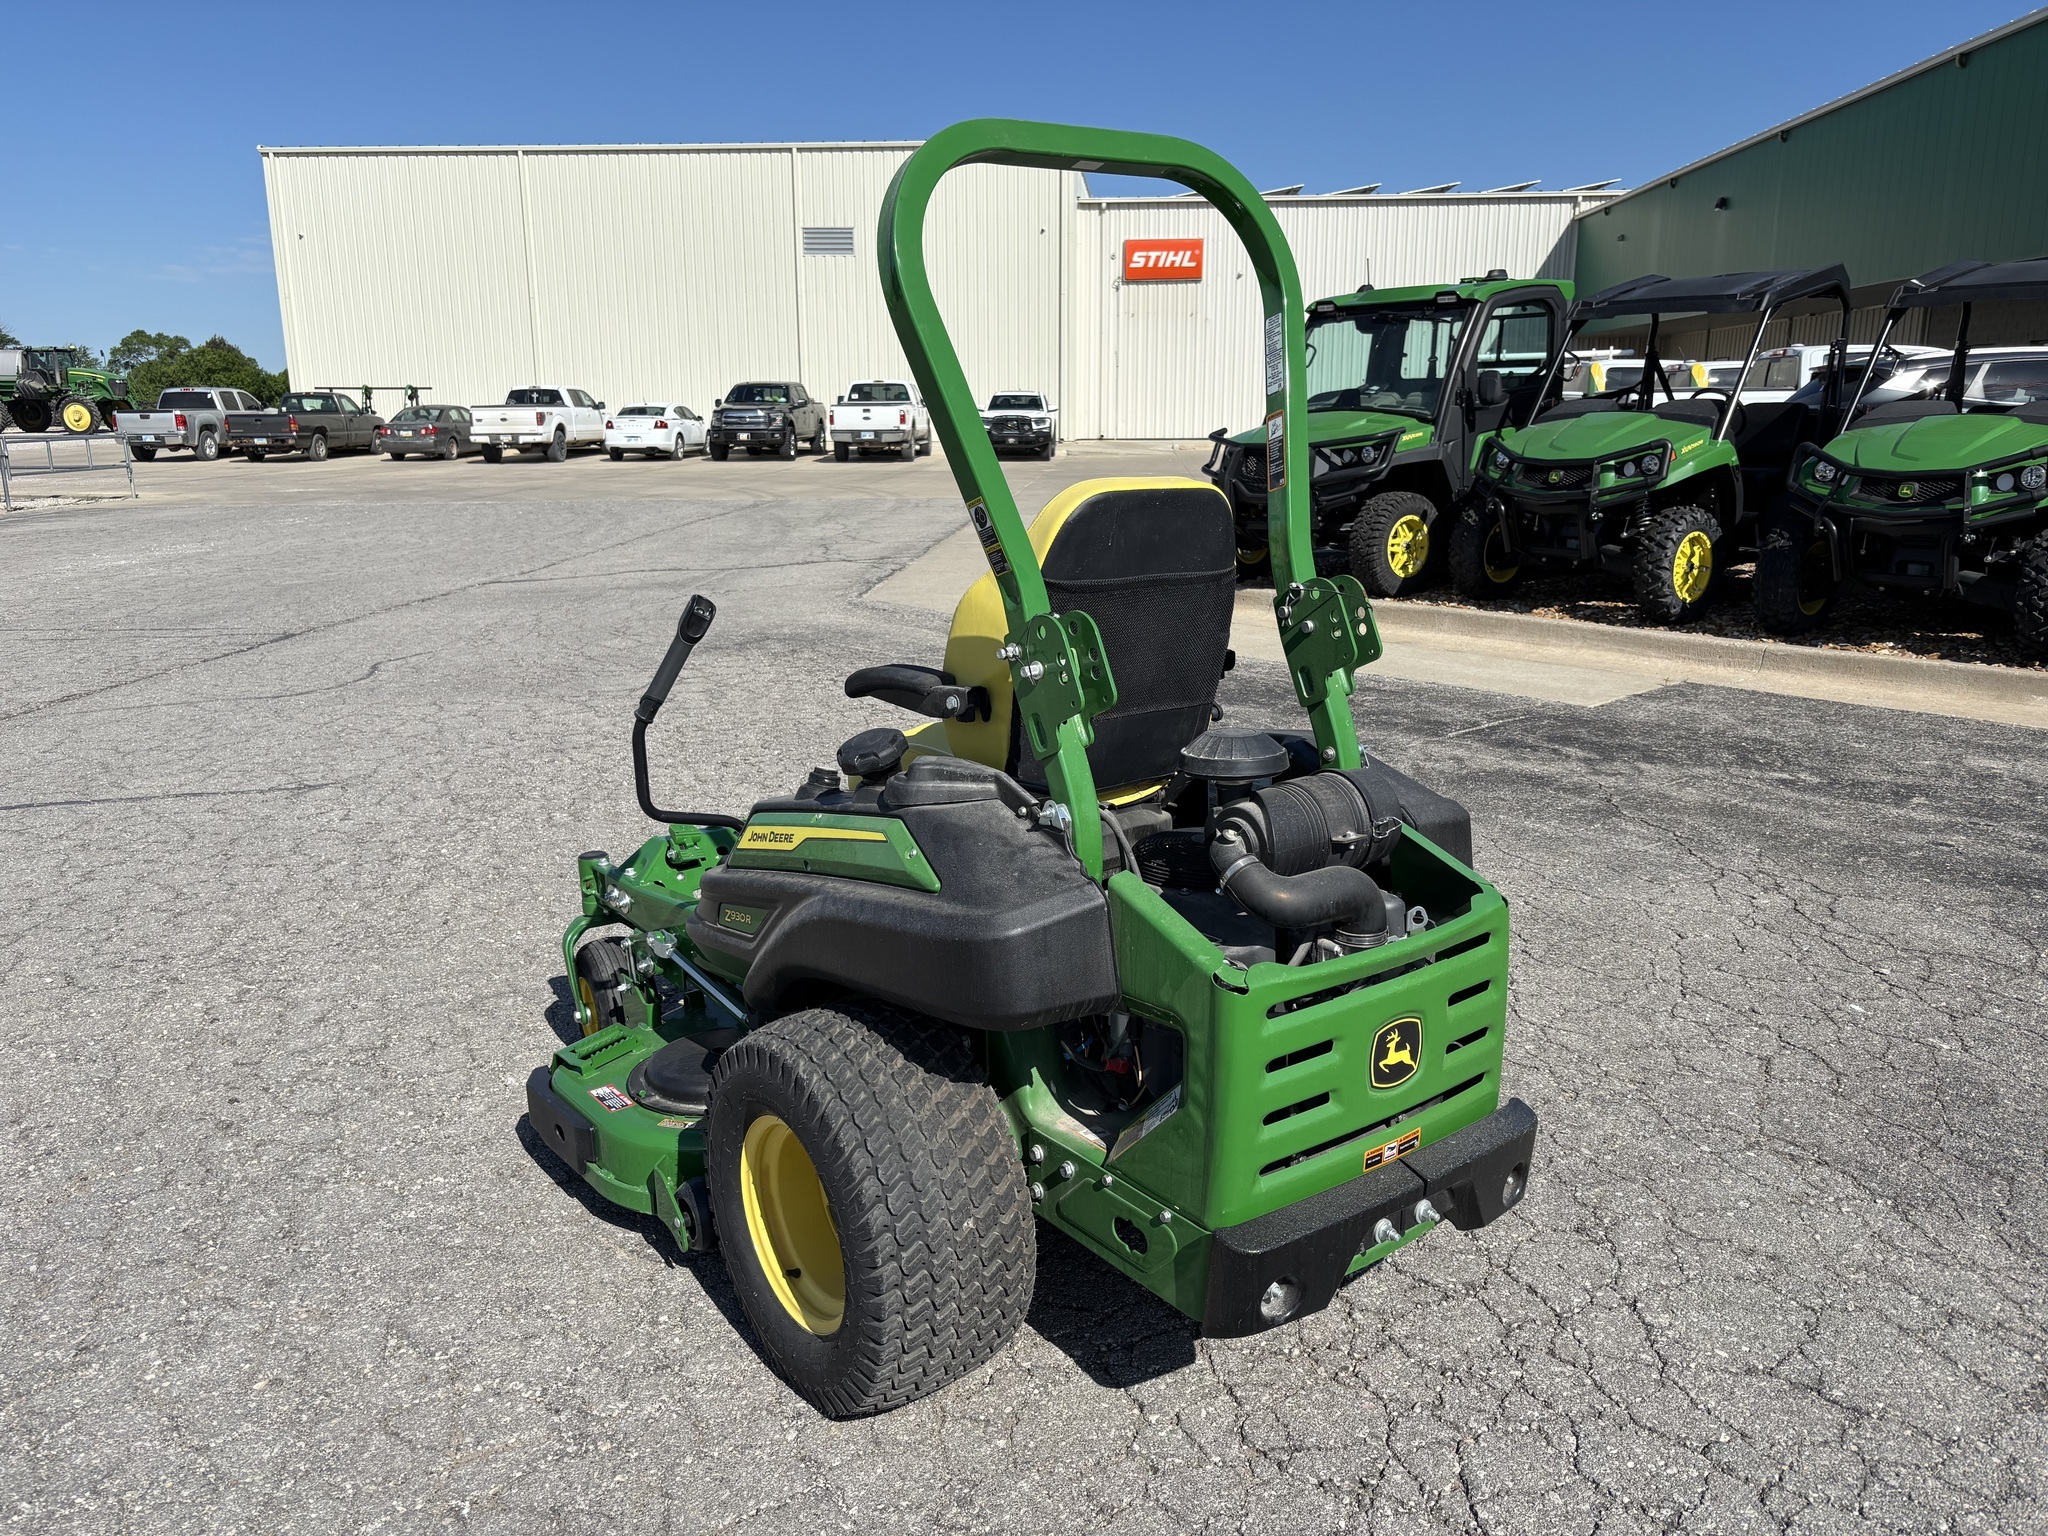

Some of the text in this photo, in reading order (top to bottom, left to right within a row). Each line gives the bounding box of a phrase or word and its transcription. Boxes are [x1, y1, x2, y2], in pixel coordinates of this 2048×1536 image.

[1129, 251, 1197, 268] STIHL
[748, 831, 794, 843] JOHN DEERE
[725, 909, 751, 924] Z930R
